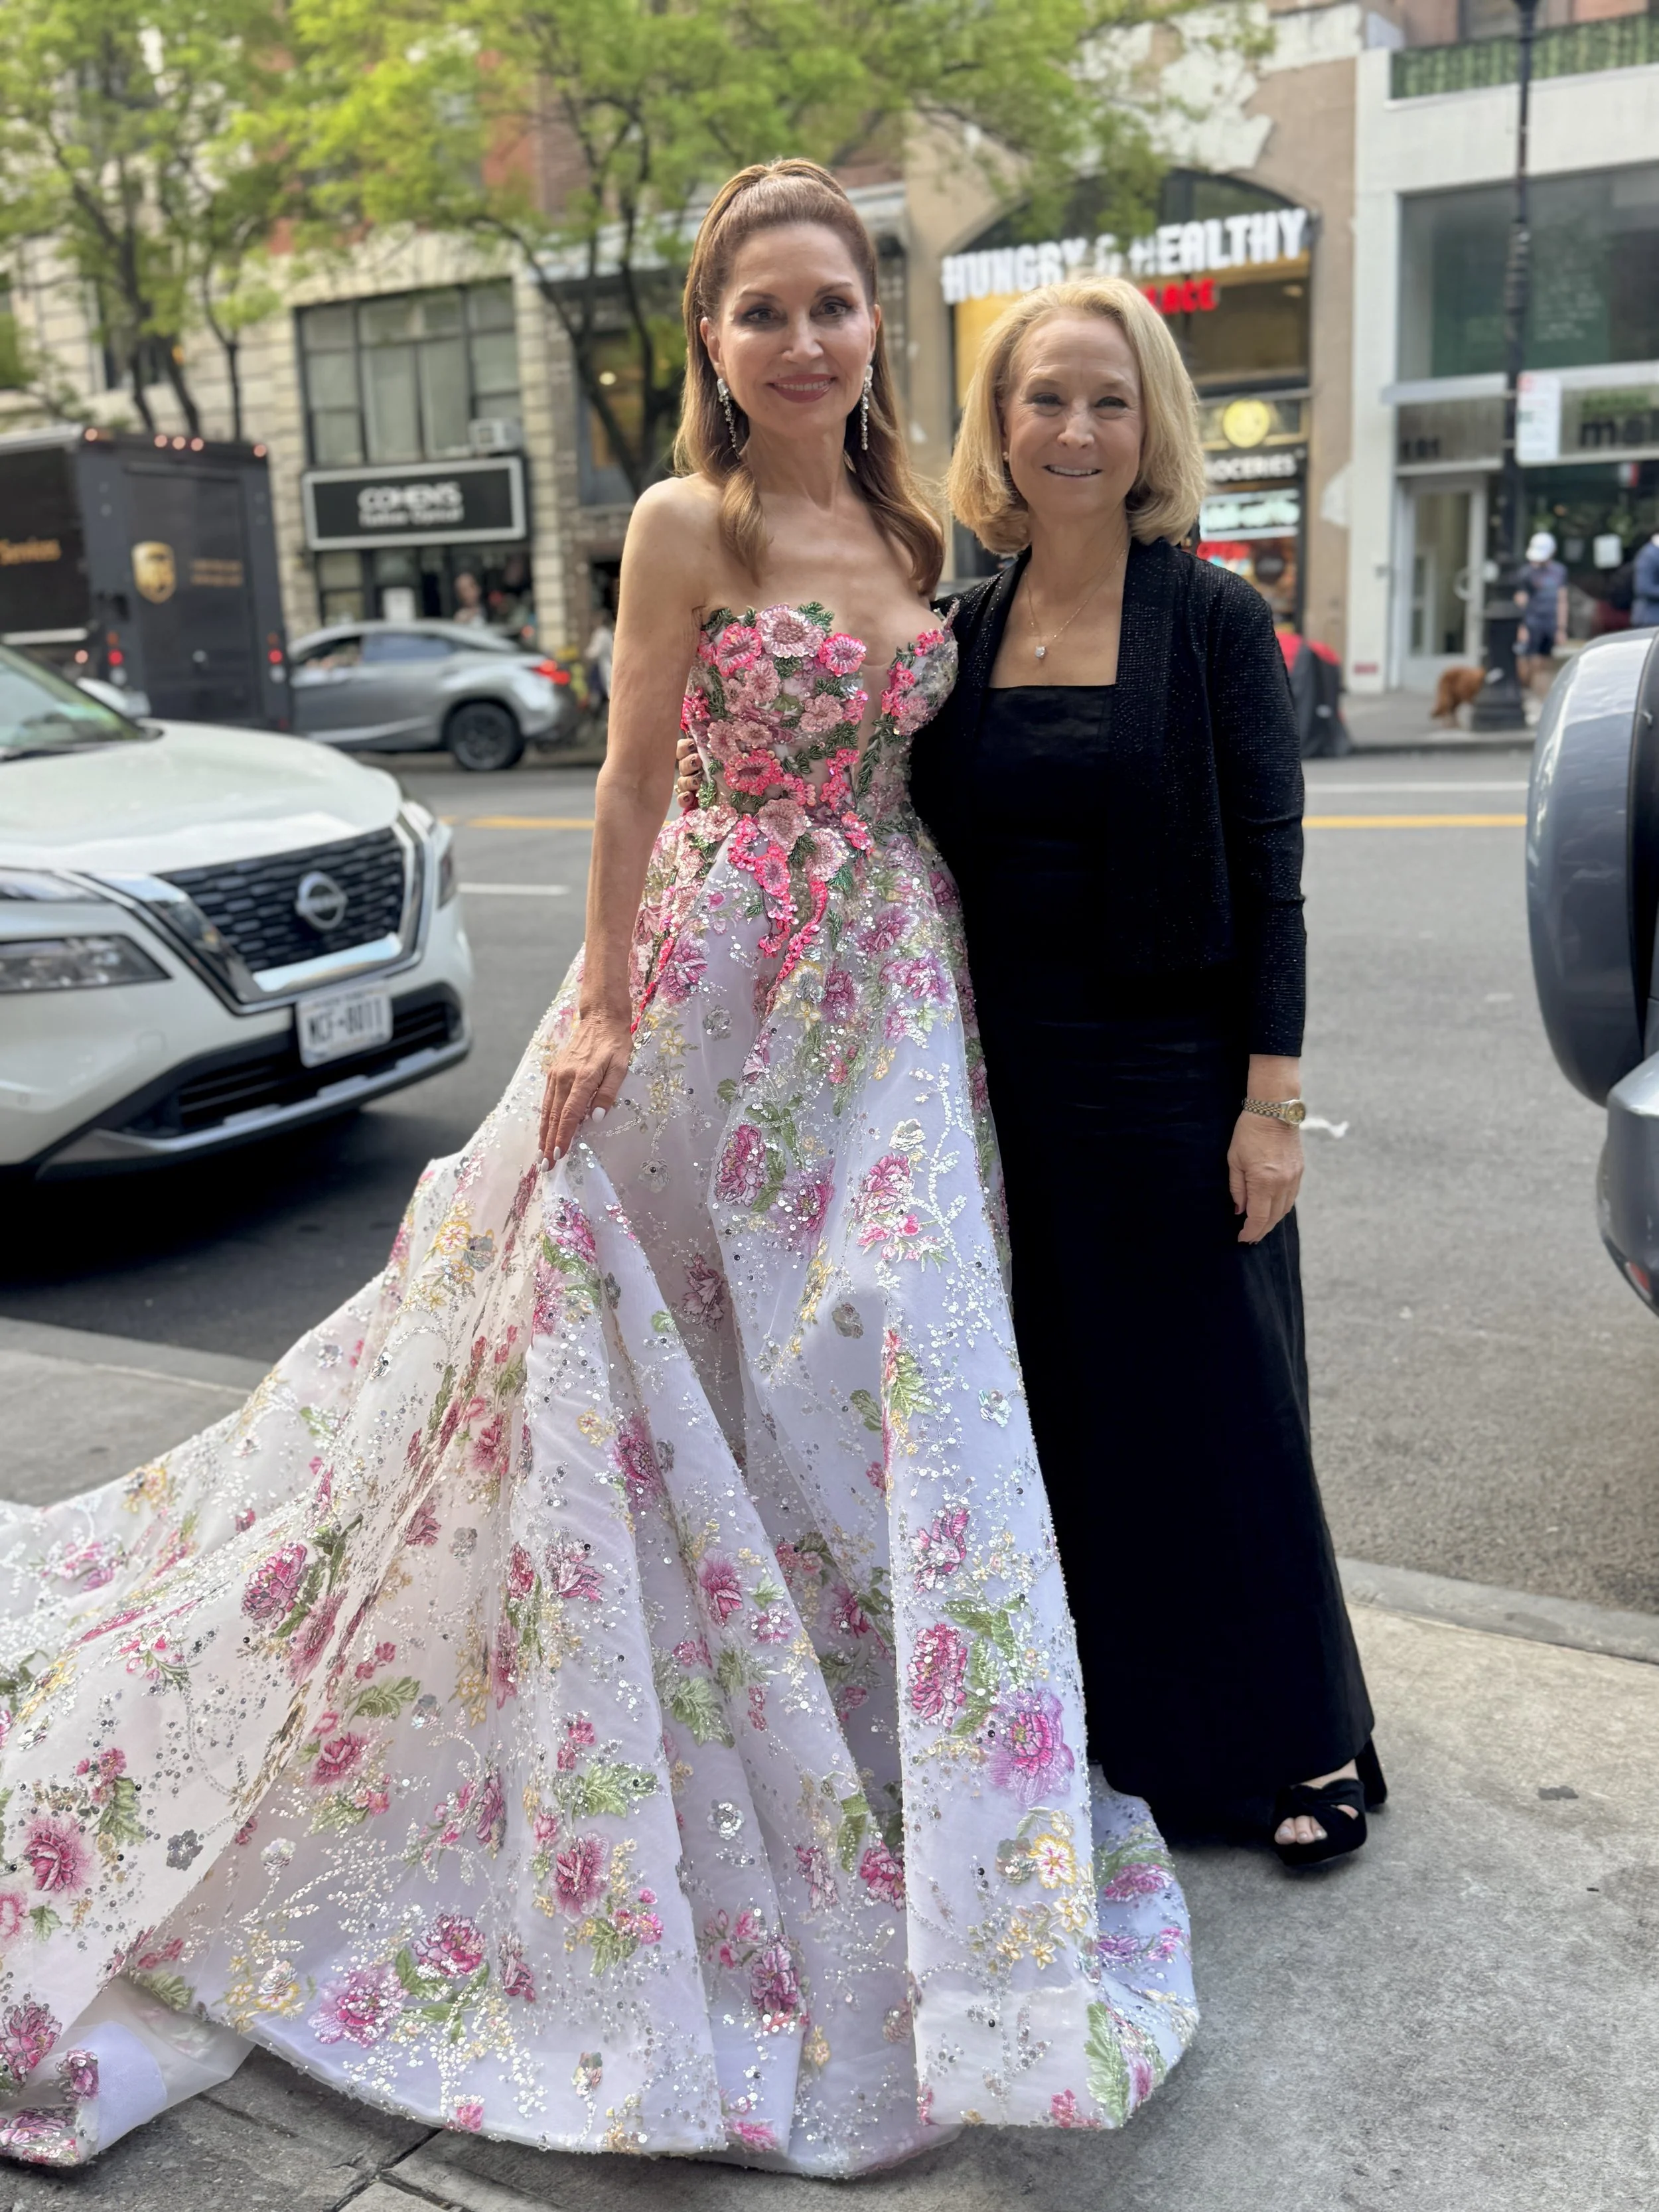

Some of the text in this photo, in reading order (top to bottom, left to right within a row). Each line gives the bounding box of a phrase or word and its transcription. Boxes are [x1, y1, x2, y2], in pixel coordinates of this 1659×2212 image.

[942, 237, 1086, 304] HUNGRY
[1128, 207, 1306, 277] HEALTHY
[1144, 277, 1217, 315] LACE
[1204, 454, 1296, 482] ROCERIES
